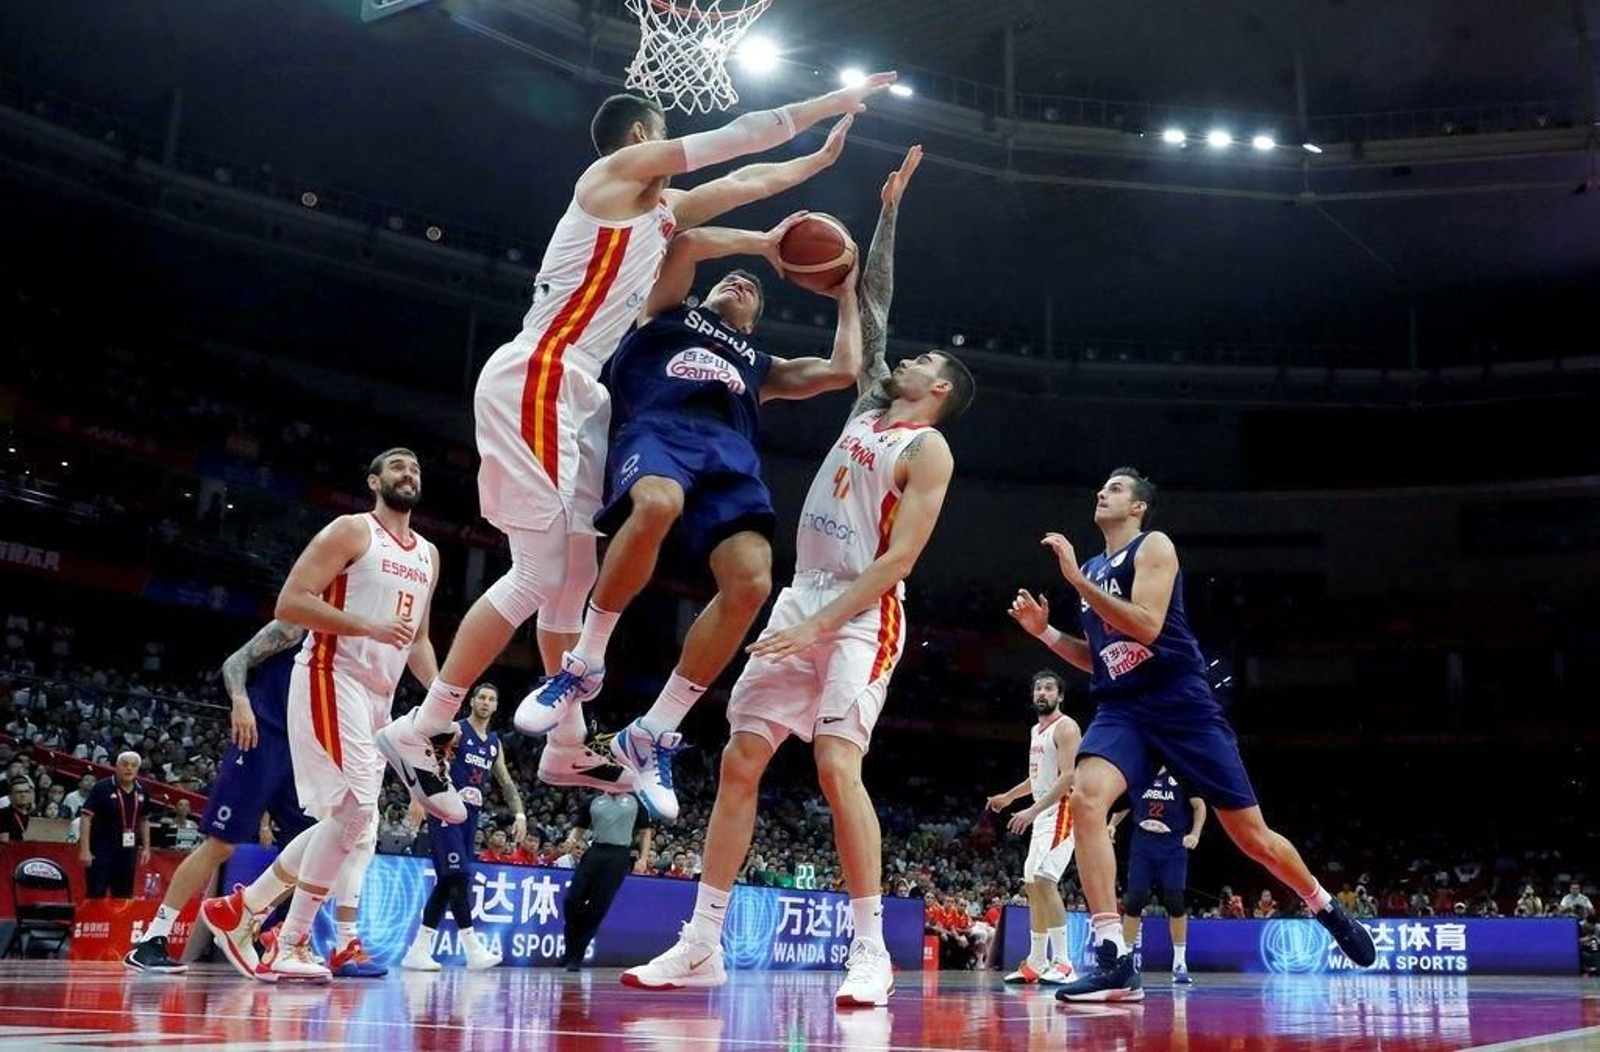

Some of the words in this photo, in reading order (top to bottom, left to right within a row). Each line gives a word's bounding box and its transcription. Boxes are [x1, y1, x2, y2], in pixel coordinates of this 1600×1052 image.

[396, 589, 415, 618] 13
[1149, 801, 1164, 818] 22
[774, 941, 826, 963] WANDA
[1395, 954, 1468, 971] SPORTS
